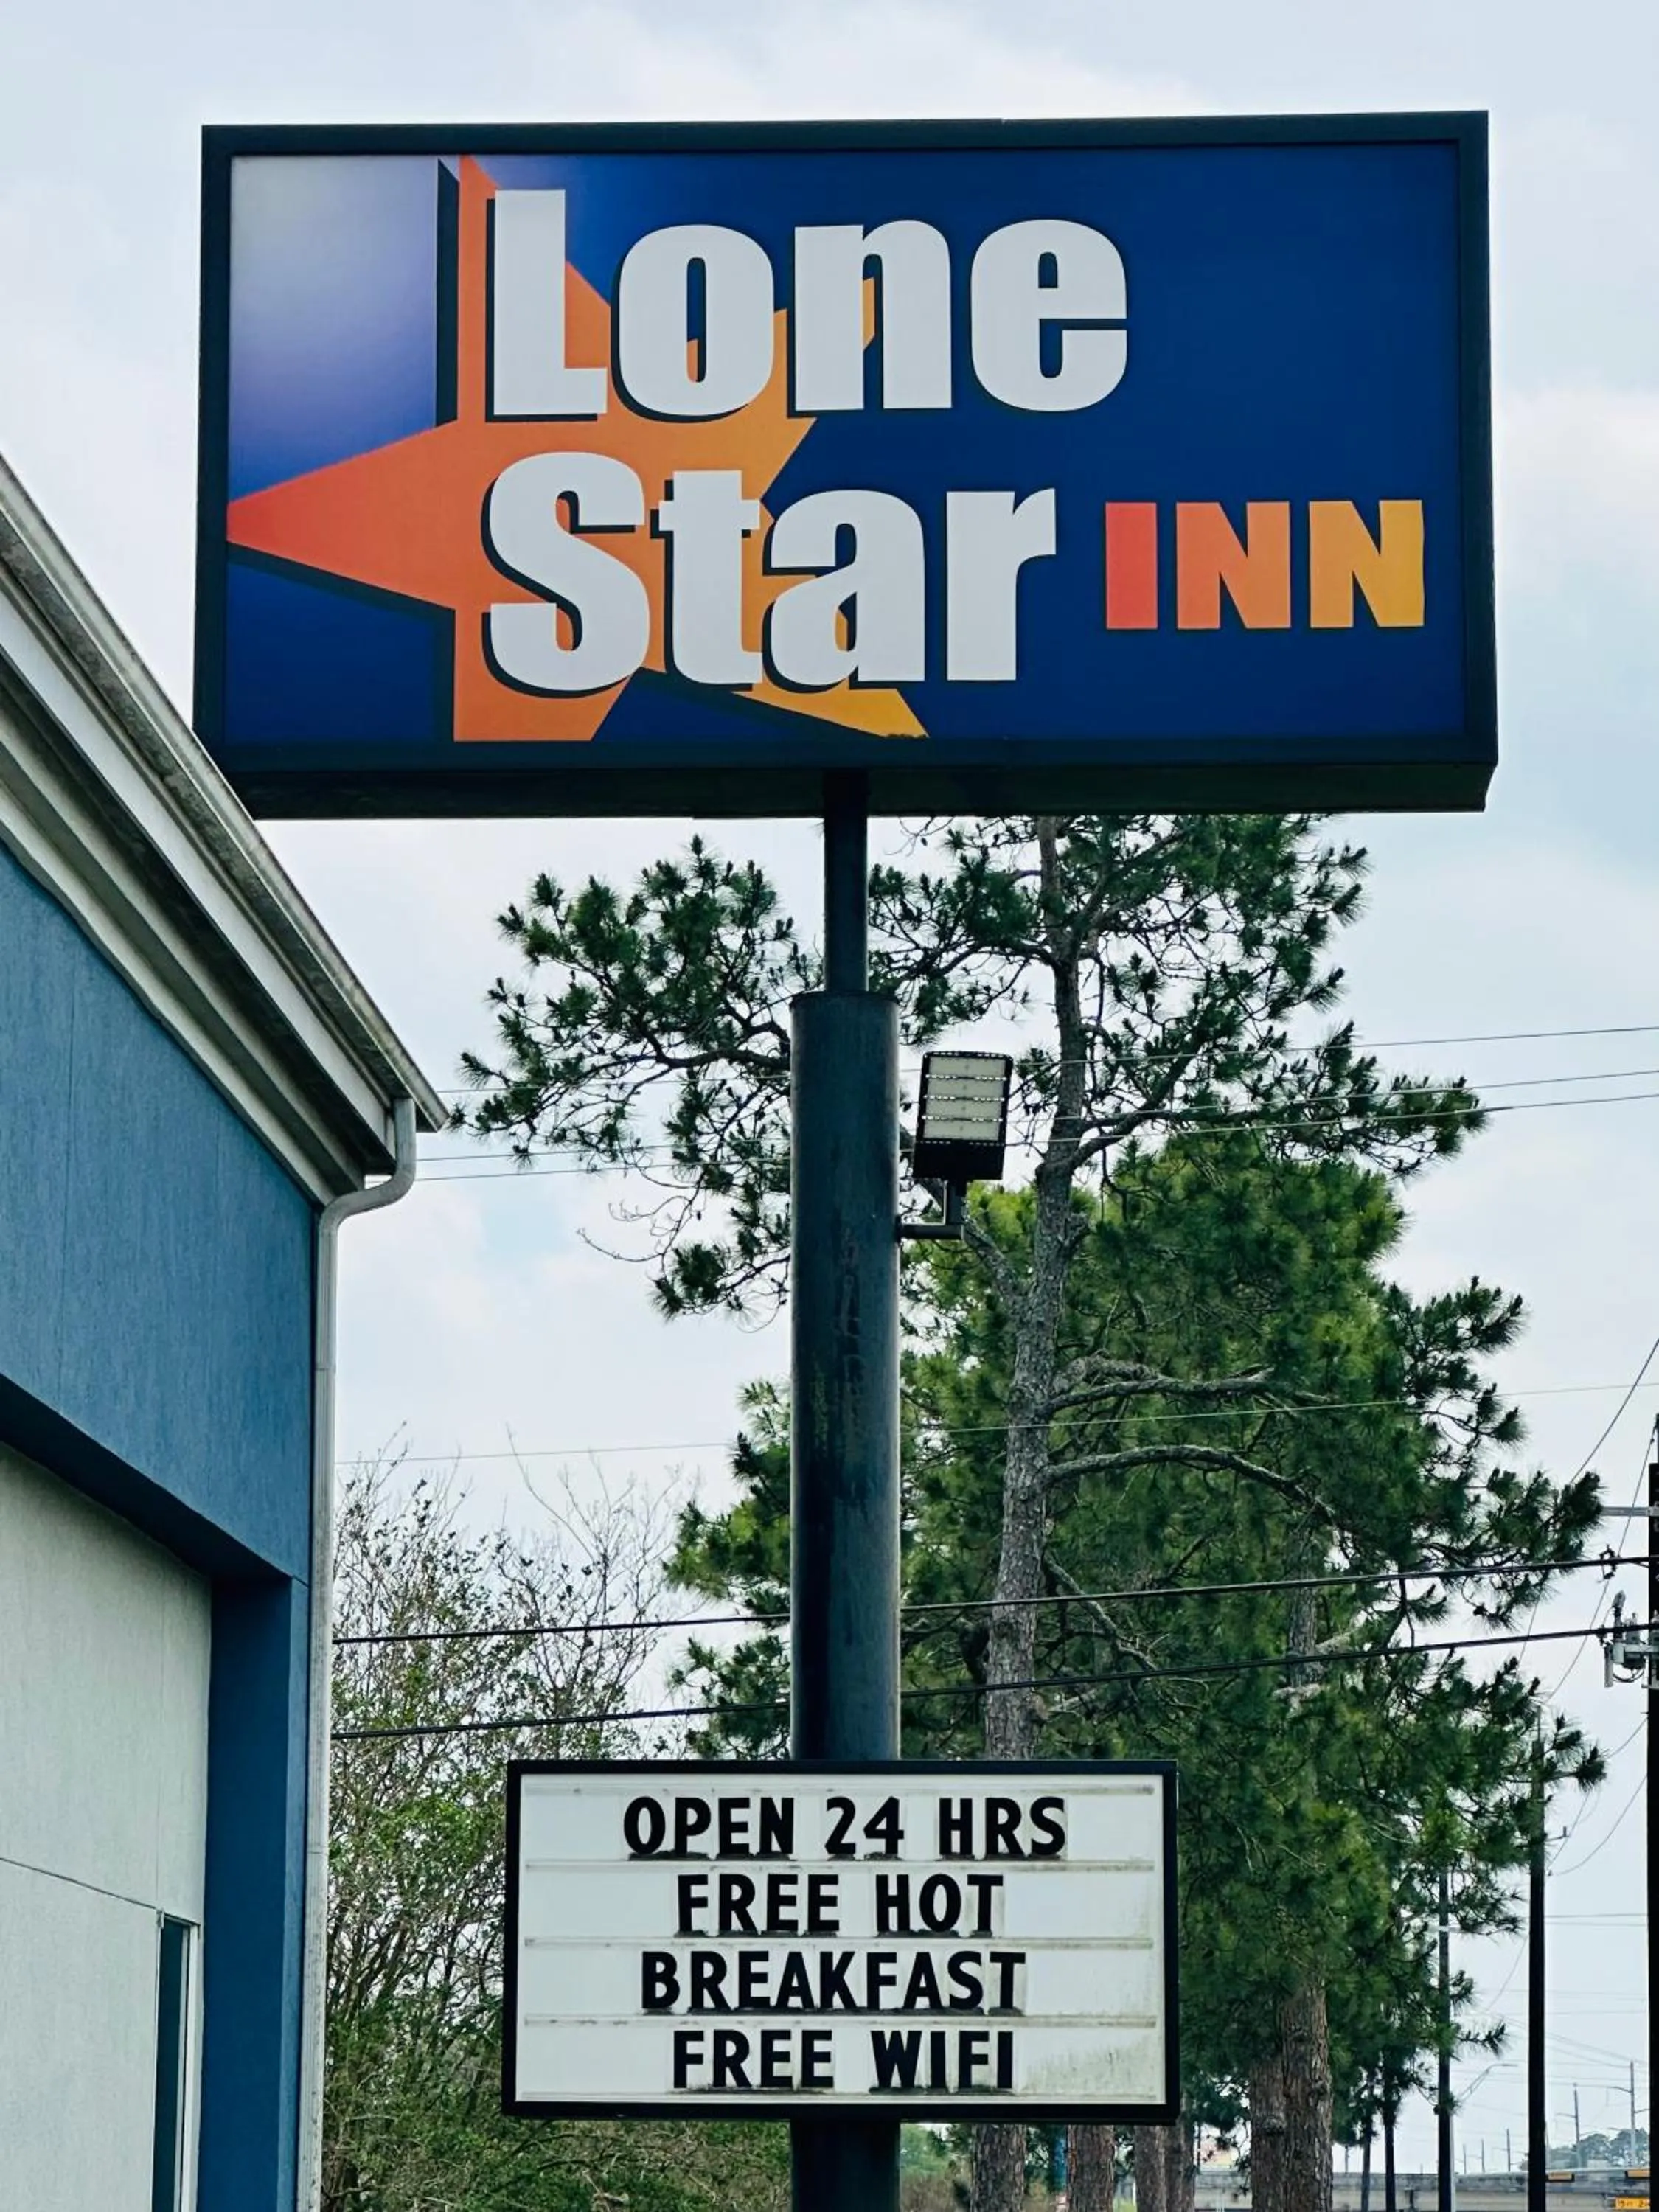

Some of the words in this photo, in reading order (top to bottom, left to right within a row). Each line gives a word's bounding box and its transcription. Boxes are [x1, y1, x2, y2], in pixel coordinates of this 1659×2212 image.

[490, 189, 1128, 421] Lone
[487, 451, 1057, 693] Star
[1105, 499, 1425, 630] INN
[623, 1796, 794, 1857] OPEN
[824, 1796, 905, 1856] 24
[939, 1796, 1067, 1857] HRS
[676, 1874, 839, 1933] FREE
[875, 1874, 1004, 1934] HOT
[641, 1951, 1026, 2011] BREAKFAST
[672, 2029, 835, 2090] FREE
[871, 2030, 1014, 2090] WIFI
